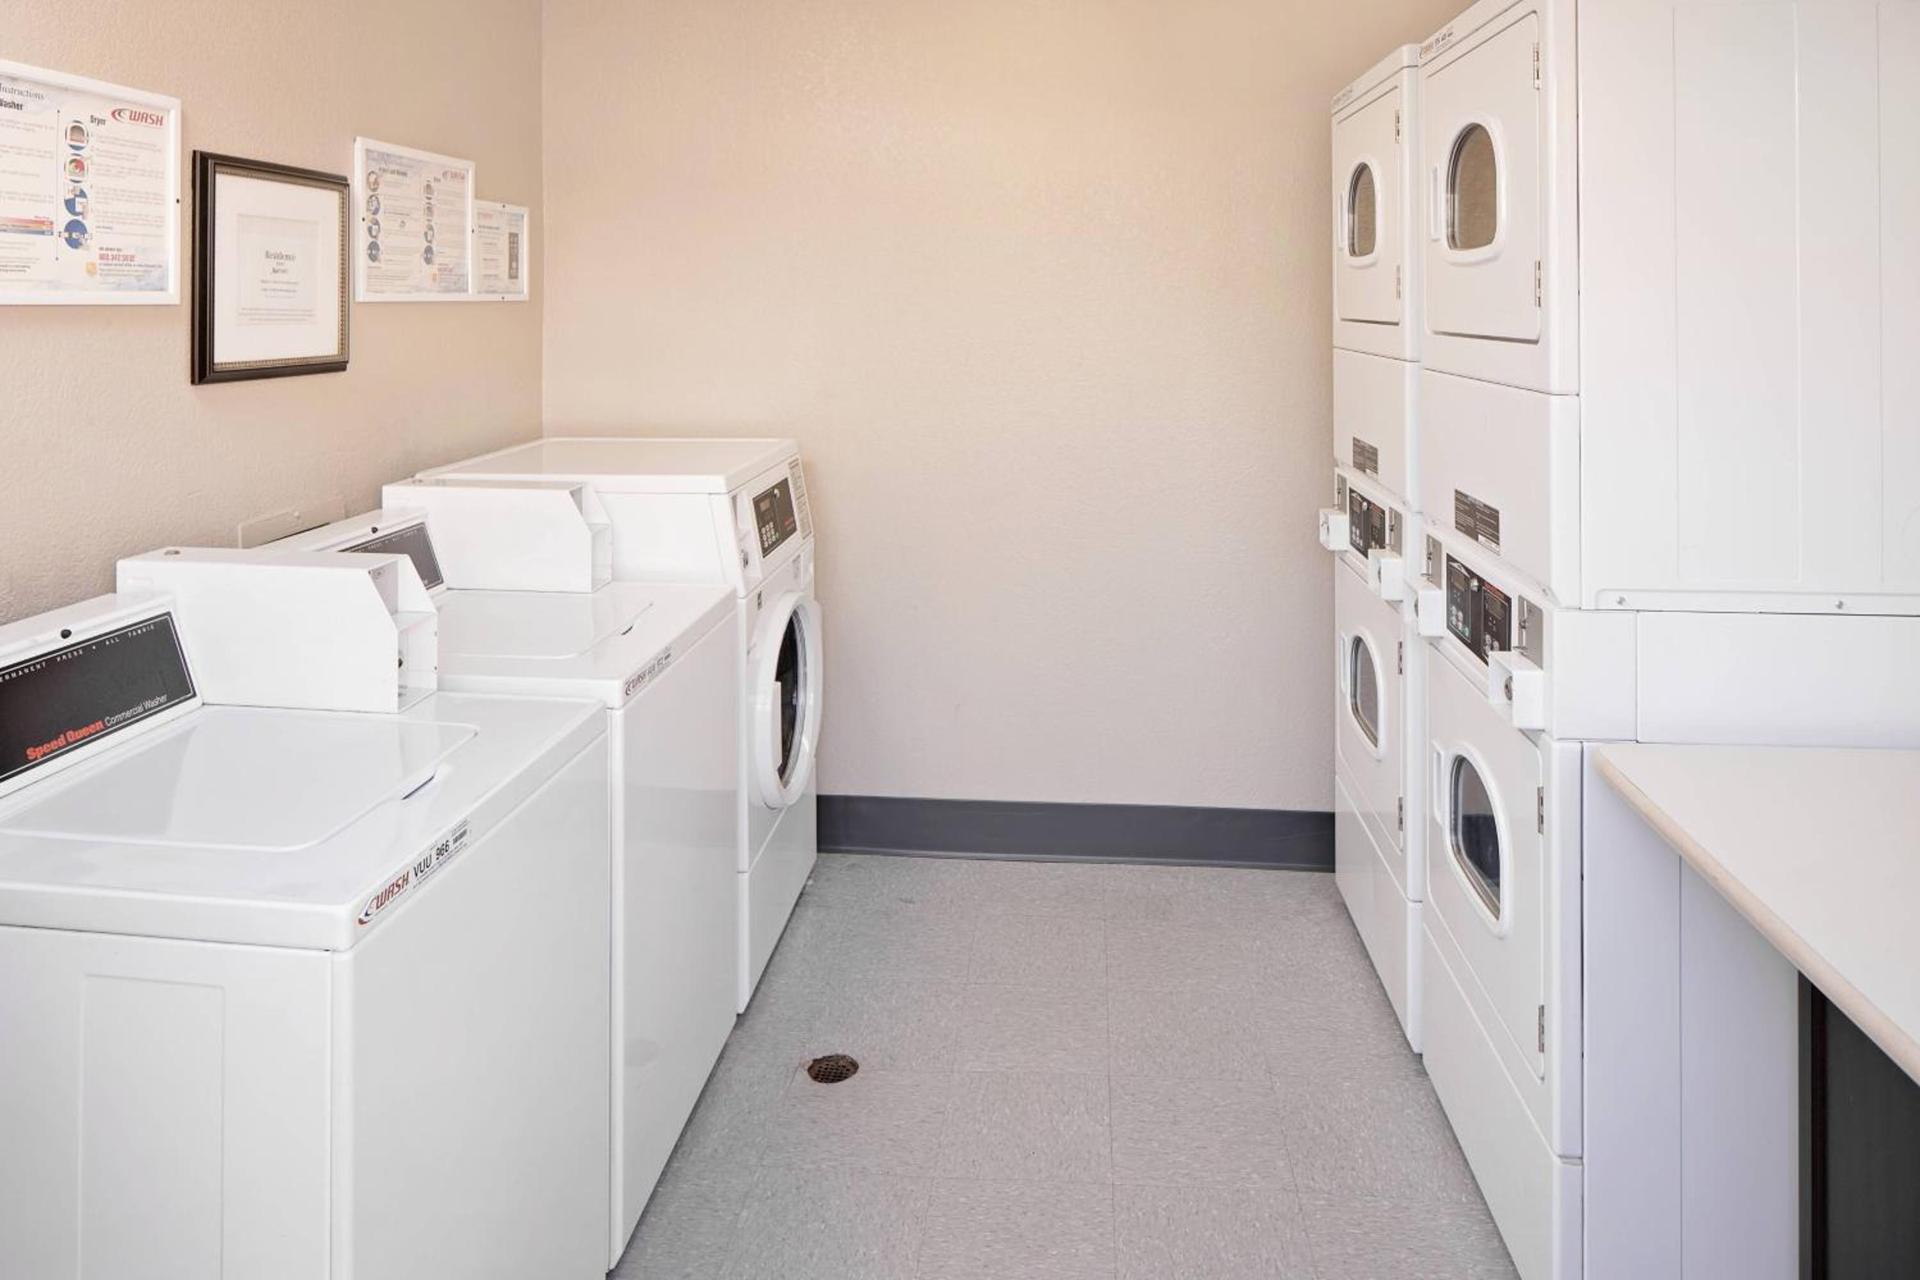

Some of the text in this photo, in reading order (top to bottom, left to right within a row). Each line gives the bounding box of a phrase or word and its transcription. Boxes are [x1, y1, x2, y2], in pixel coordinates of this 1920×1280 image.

[128, 109, 164, 126] WASH
[26, 693, 168, 761] Speed Queen Commercial Washer
[375, 840, 450, 910] WASH VUU 966
